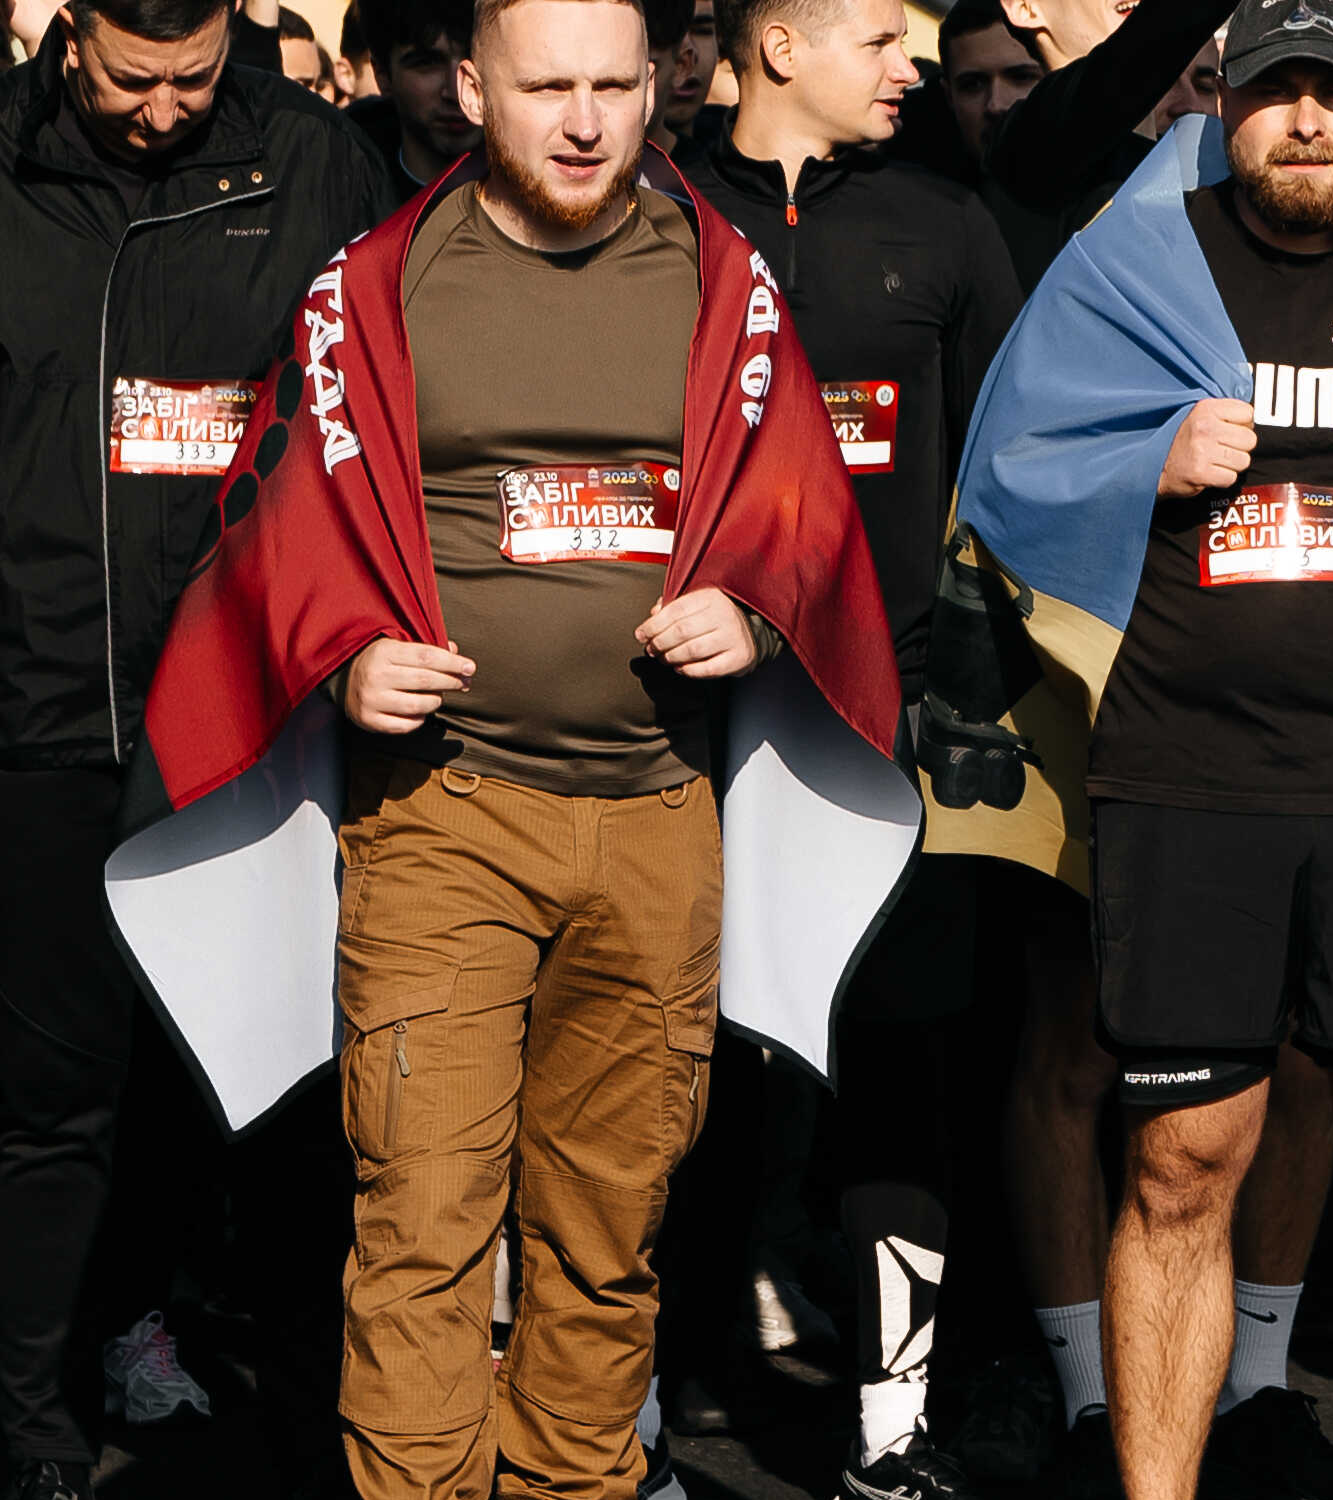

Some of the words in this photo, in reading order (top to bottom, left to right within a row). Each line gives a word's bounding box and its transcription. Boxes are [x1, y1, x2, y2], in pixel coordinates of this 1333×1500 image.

[304, 236, 364, 476] ГАДА
[215, 389, 247, 402] 2025
[121, 396, 196, 418] ЗАБІГ
[121, 417, 247, 442] СМІЛИВИ
[176, 442, 216, 460] 333
[533, 472, 558, 482] 23.10
[602, 472, 637, 485] 2025
[505, 482, 585, 507] ЗАБІГ
[1302, 492, 1333, 507] 2025
[1208, 502, 1284, 530] ЗАБІГ
[569, 527, 621, 551] 332
